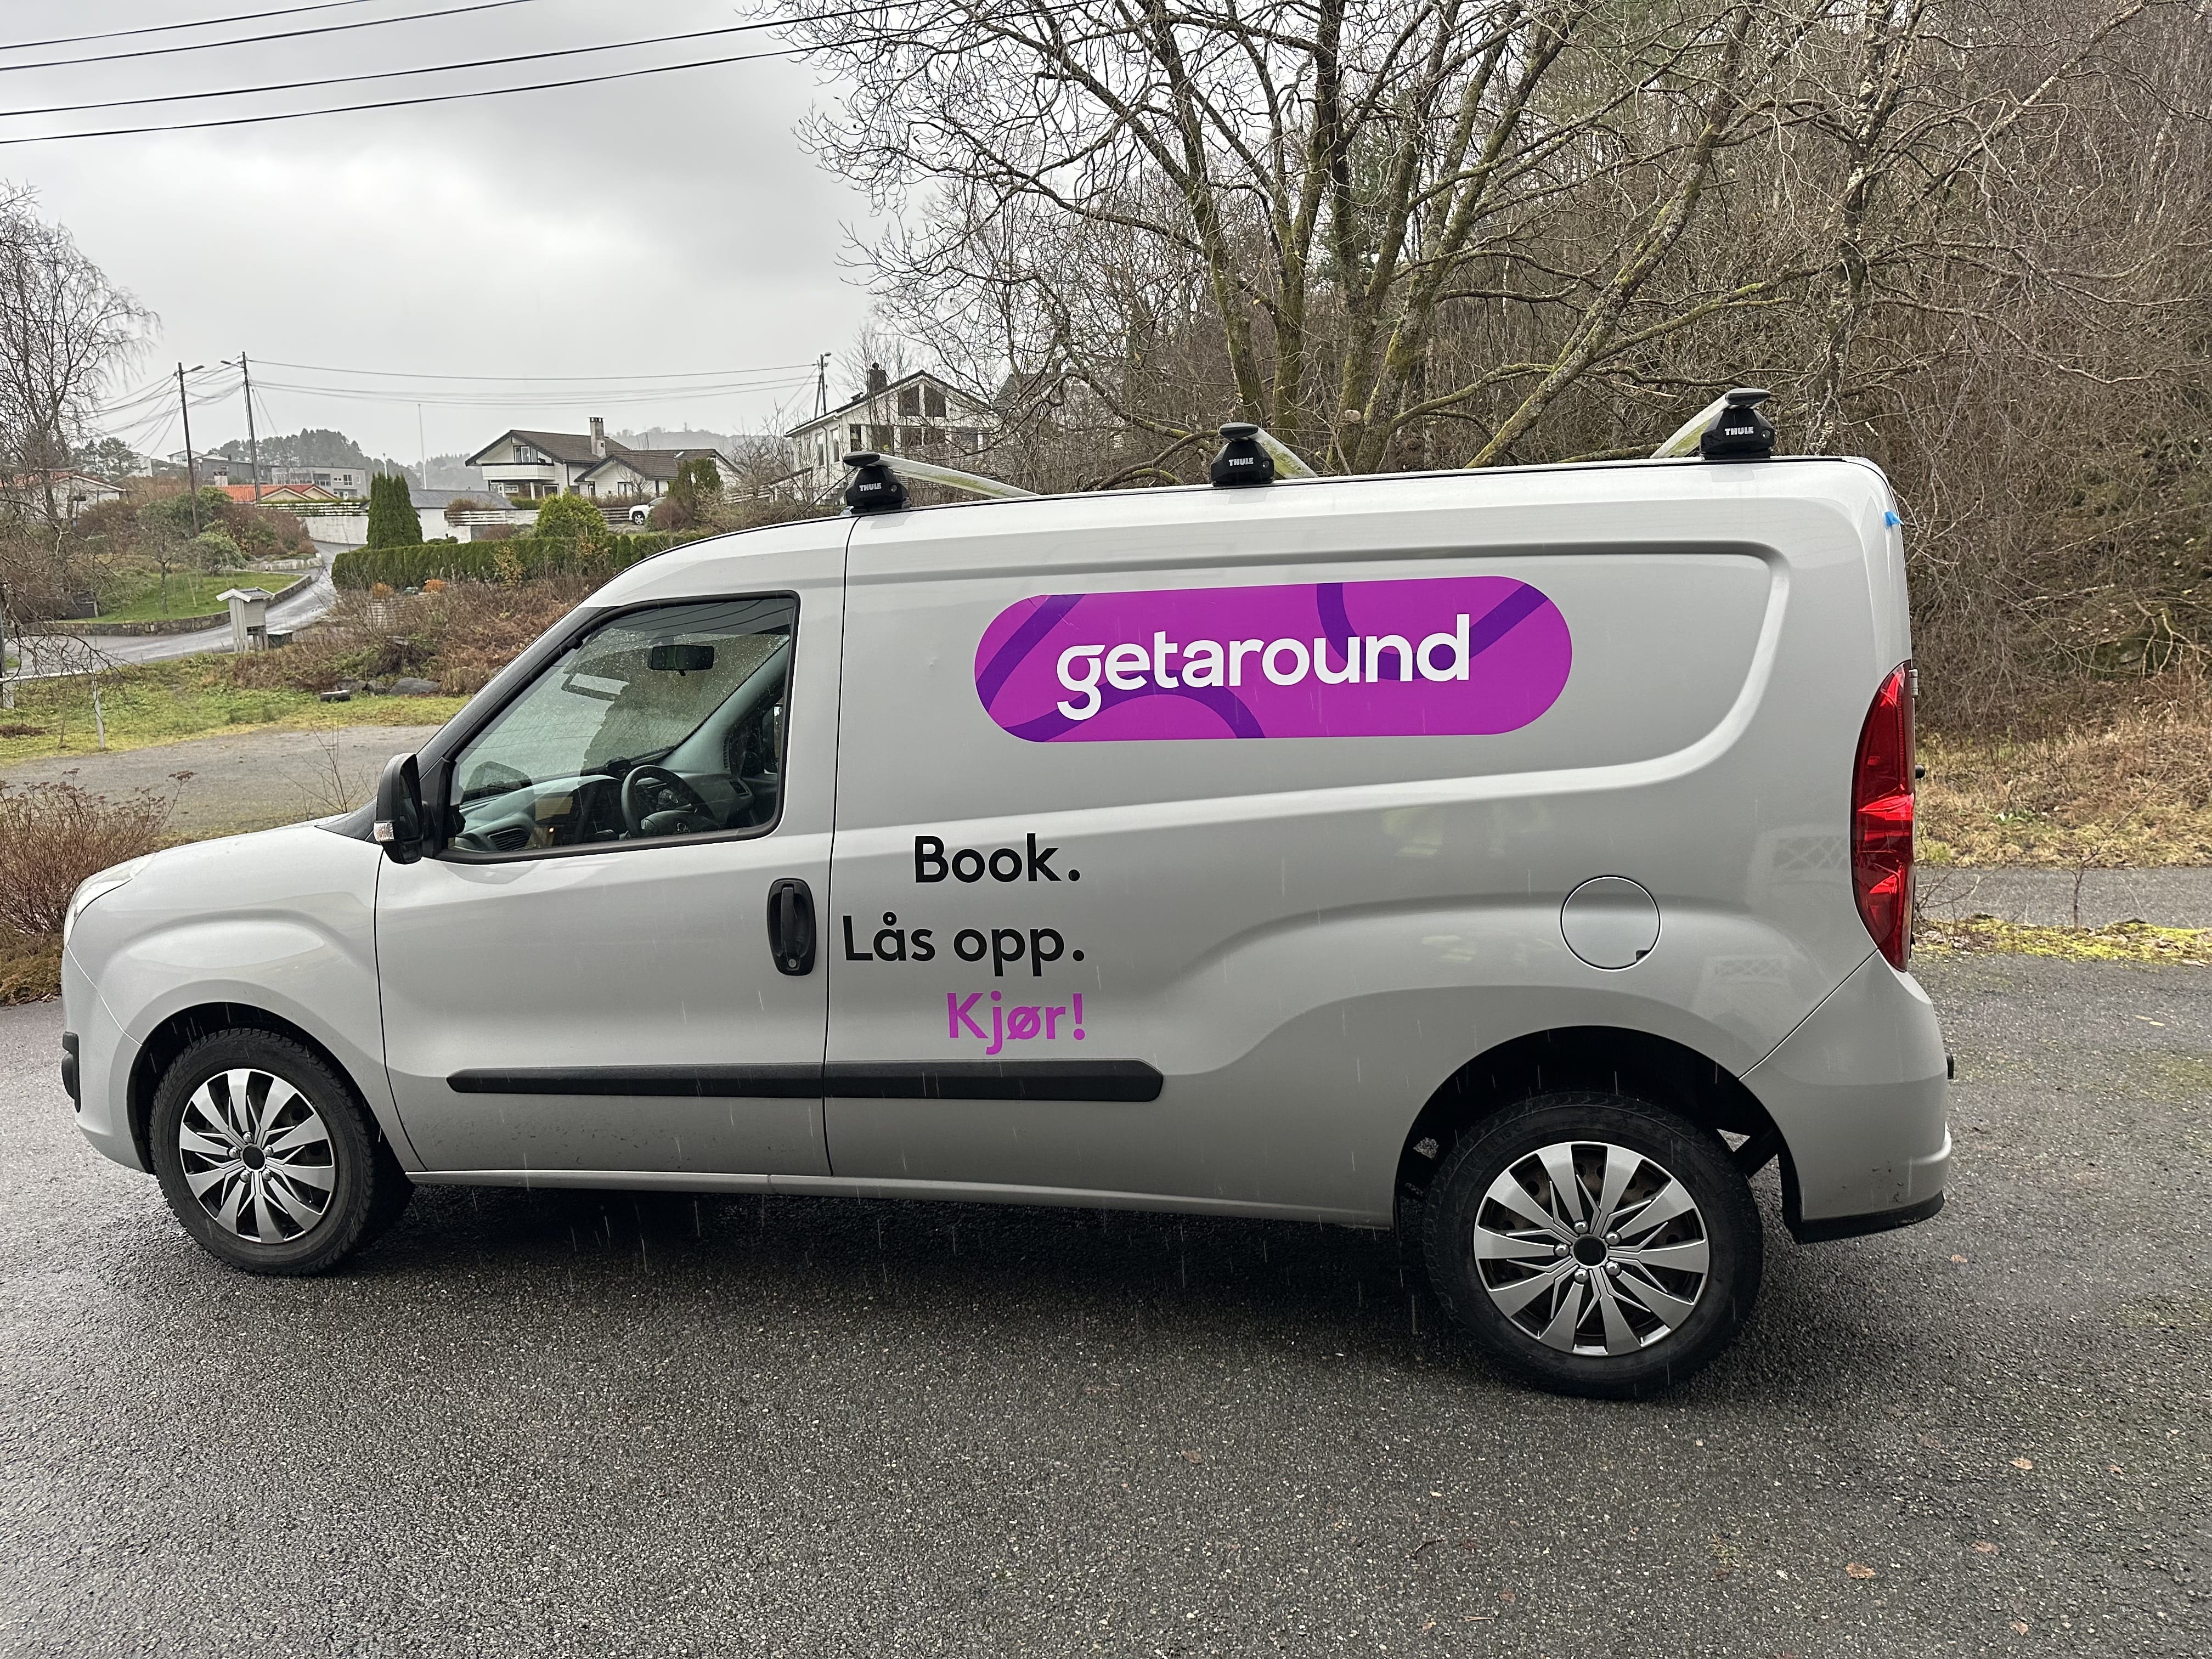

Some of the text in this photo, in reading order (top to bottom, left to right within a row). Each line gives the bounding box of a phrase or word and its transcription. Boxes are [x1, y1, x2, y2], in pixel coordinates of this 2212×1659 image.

[1724, 426, 1754, 436] THULE
[1228, 457, 1254, 466] THULE
[859, 482, 882, 492] THULE
[1057, 613, 1470, 720] getaround
[914, 833, 1081, 883] Book.
[842, 911, 1085, 977] Lås opp.
[946, 990, 1086, 1055] Kjør!
